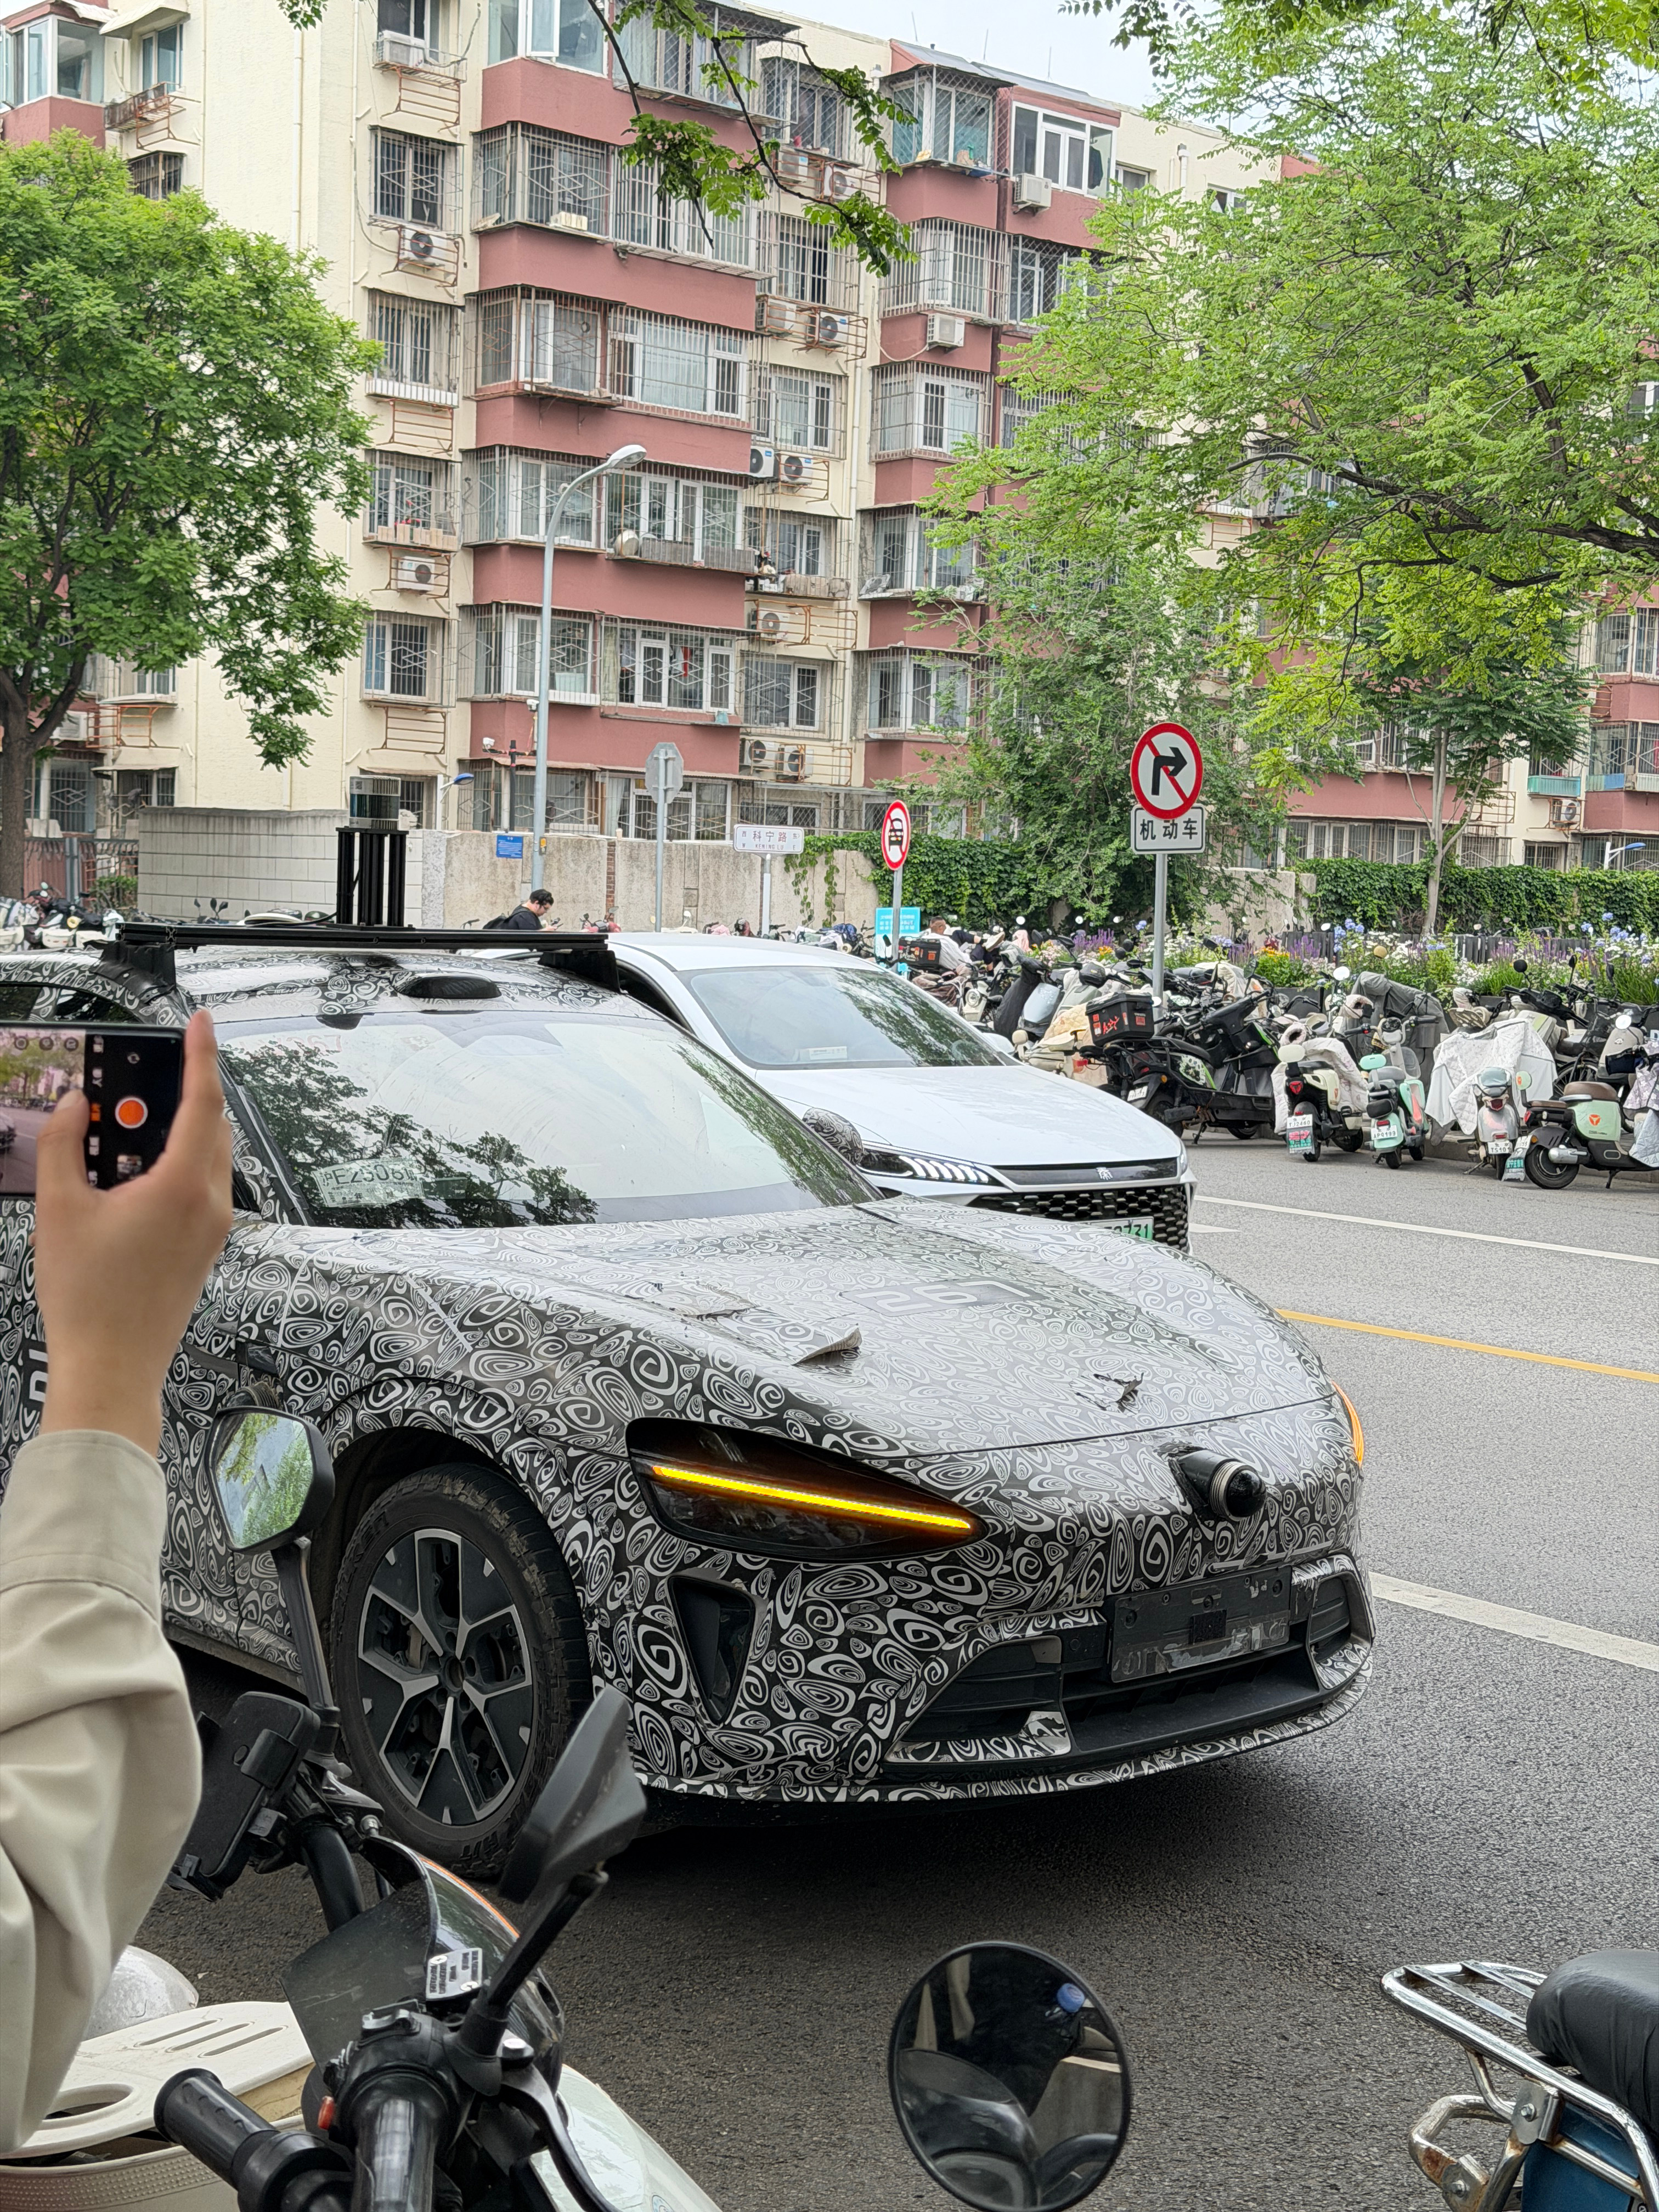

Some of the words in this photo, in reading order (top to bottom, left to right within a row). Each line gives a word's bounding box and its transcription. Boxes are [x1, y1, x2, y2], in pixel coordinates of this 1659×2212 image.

[753, 830, 787, 843] 科宁路
[1139, 817, 1198, 841] 机动车
[854, 1280, 1031, 1313] 267
